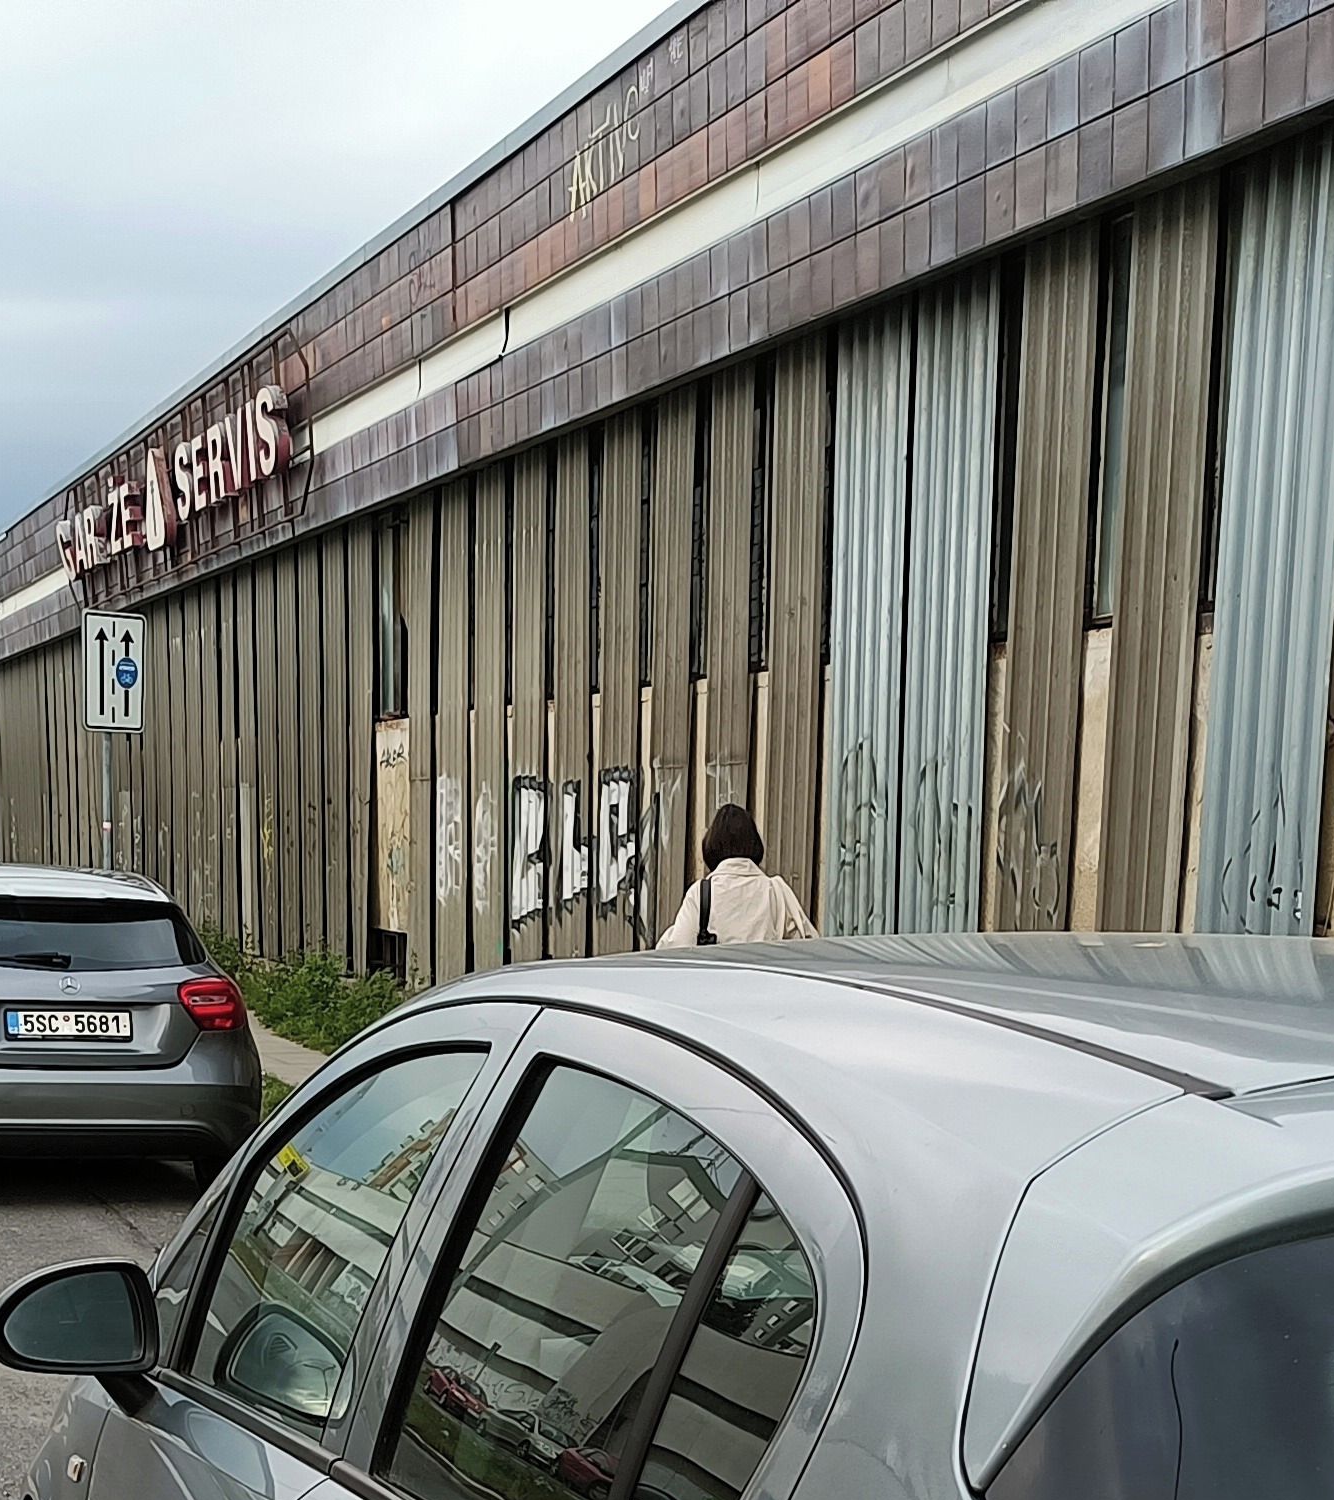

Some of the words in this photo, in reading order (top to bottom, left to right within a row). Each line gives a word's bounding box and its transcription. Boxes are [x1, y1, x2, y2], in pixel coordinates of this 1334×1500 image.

[175, 385, 289, 521] SERVIS
[23, 1014, 59, 1033] 5SC
[74, 1014, 120, 1034] 5681
